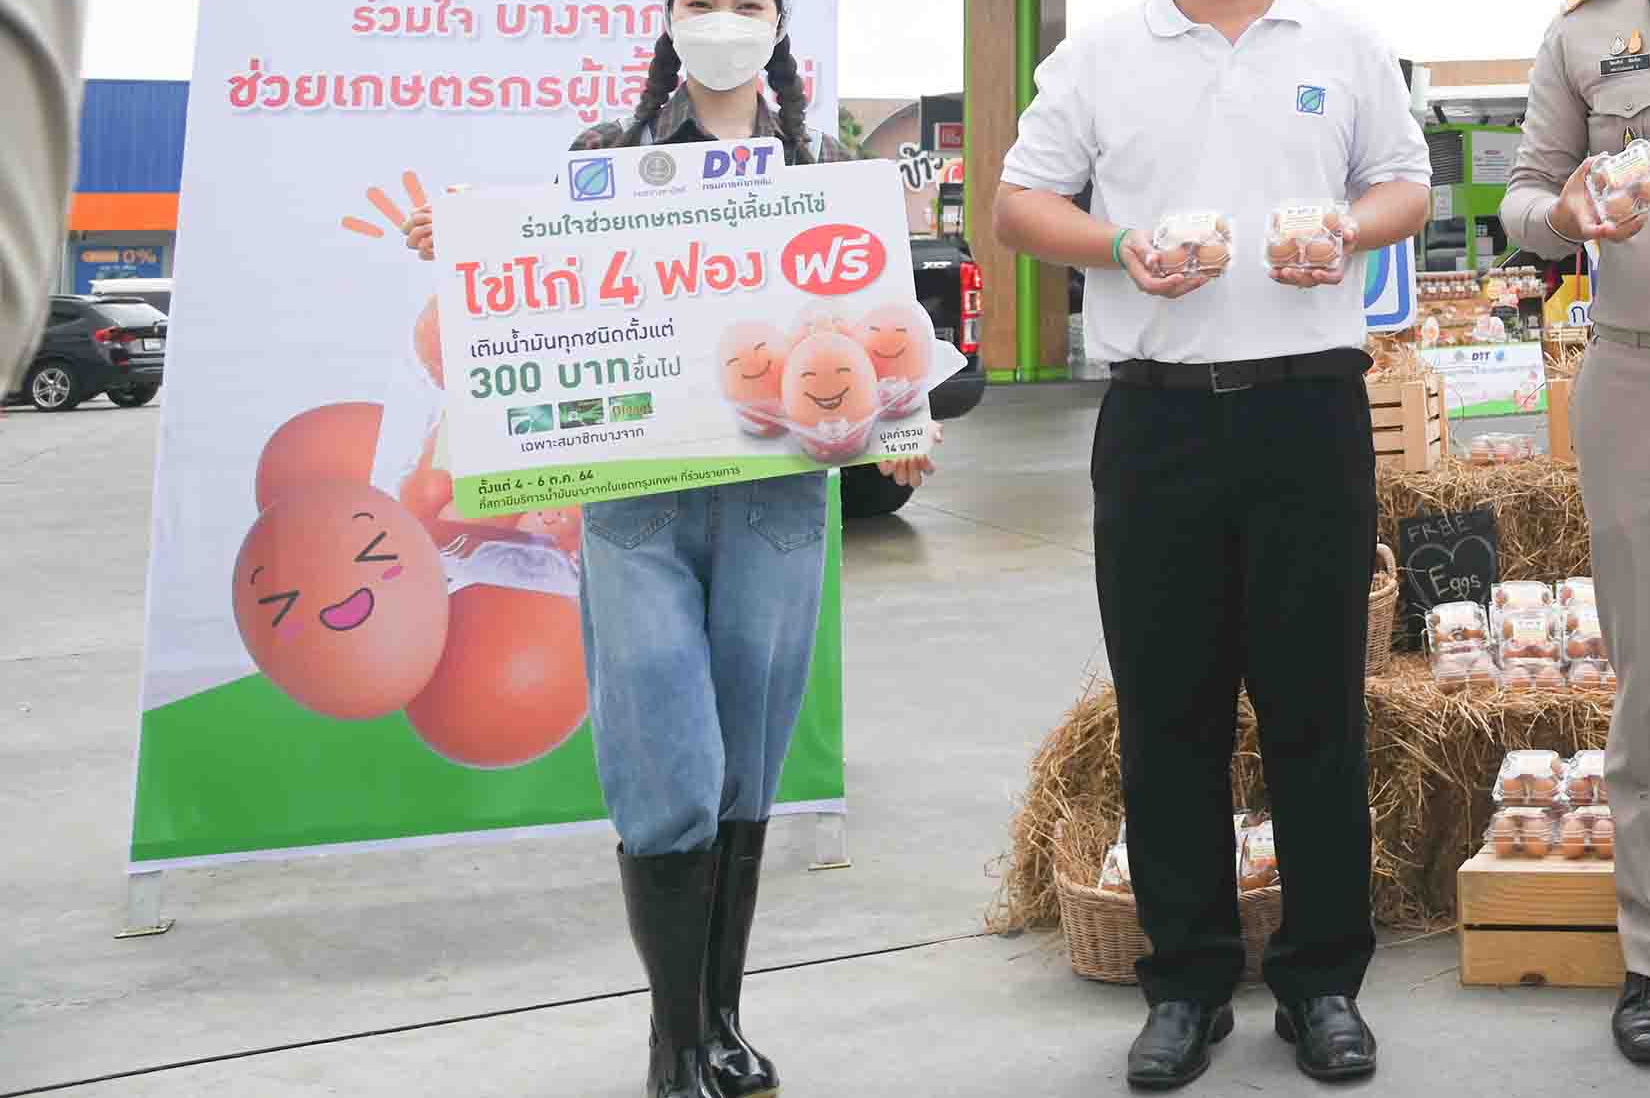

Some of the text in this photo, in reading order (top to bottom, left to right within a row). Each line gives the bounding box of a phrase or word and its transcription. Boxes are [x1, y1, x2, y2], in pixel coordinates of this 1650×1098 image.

[496, 0, 664, 36] บางจาก
[703, 145, 774, 180] DIT
[521, 191, 826, 240] ร่วมใจช่วยเกษตรกรผู้เลี้ยงไก่ไข่
[456, 234, 871, 315] ไข่ไก่ 4 ฟอง ฟรี
[470, 318, 675, 359] เติมน้ำมันทุกชนิดตั้งแต่
[469, 362, 542, 399] 300
[520, 427, 645, 454] เฉพาะสมาชิกบางจาก
[884, 440, 919, 453] 14 บาท
[478, 477, 511, 496] ตั้งแต่
[515, 478, 524, 490] 4
[537, 476, 545, 488] 6
[549, 473, 576, 487] ต.ค.
[579, 469, 595, 482] 64
[1427, 562, 1481, 600] Eggs
